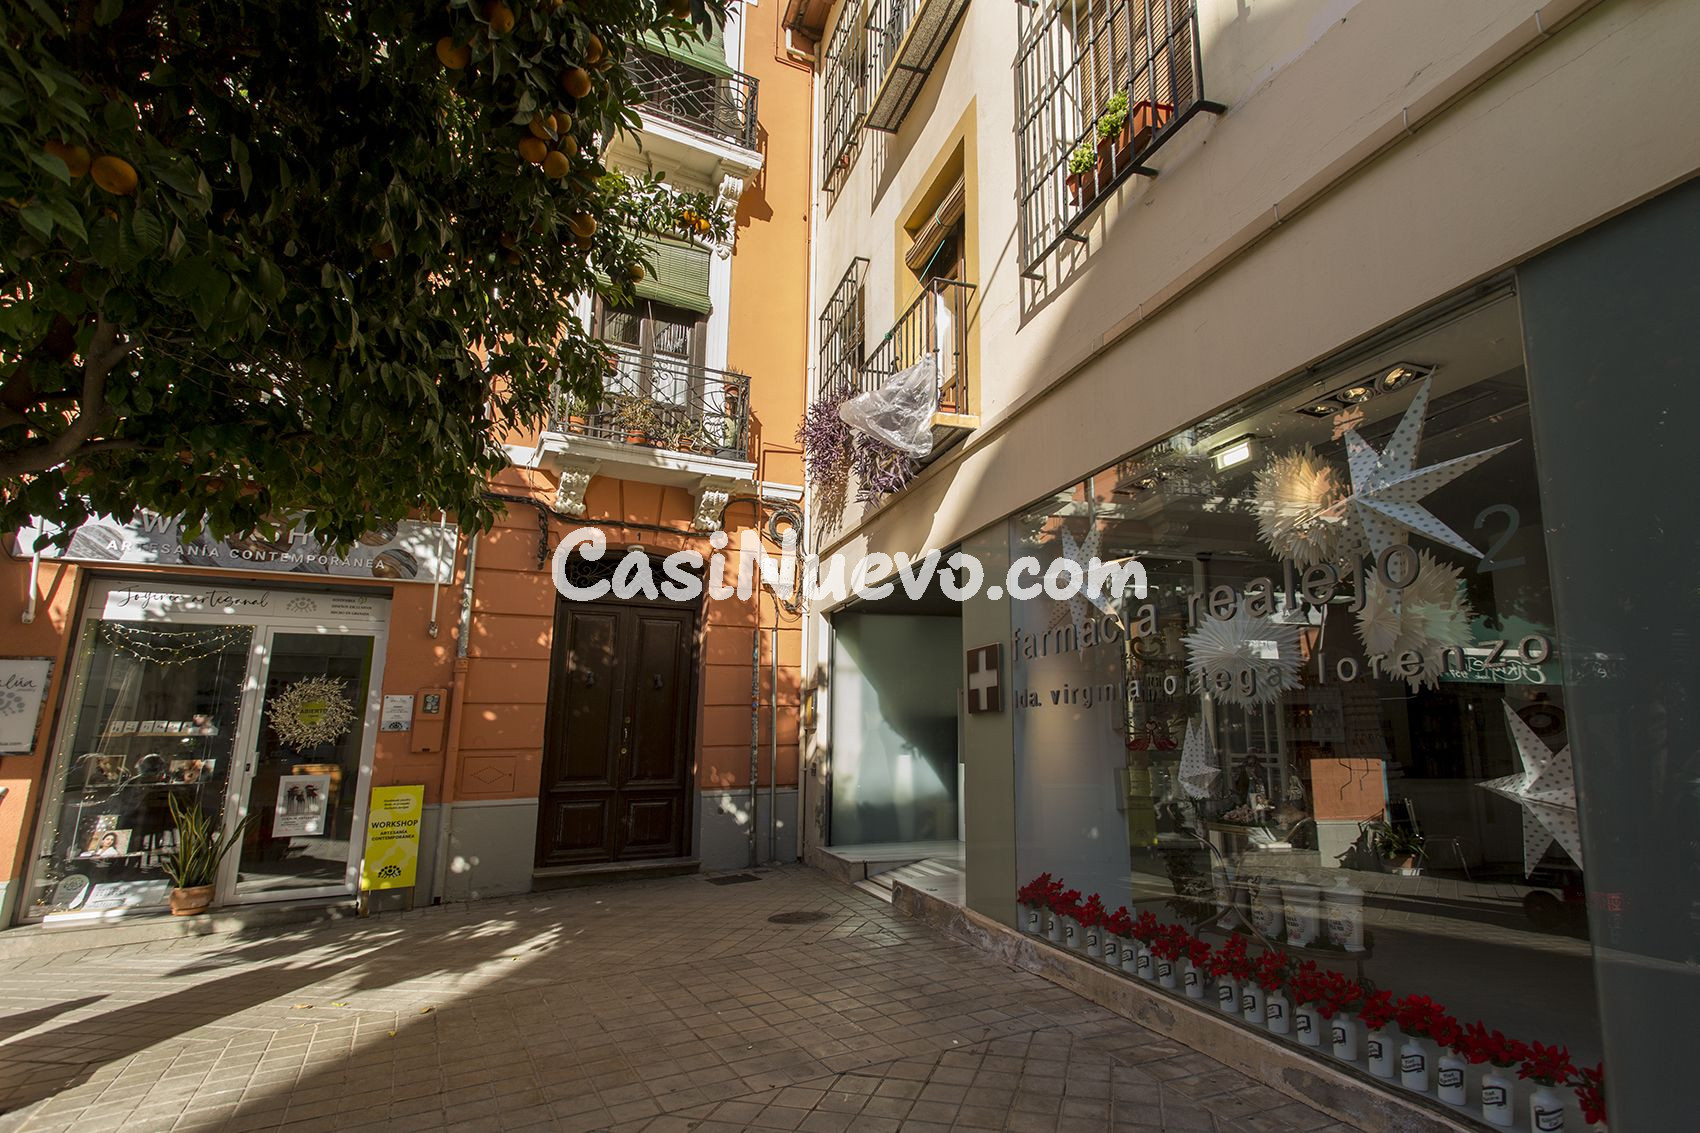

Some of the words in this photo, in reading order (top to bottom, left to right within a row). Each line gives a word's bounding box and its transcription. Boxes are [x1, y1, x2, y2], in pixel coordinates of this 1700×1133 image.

[1473, 503, 1527, 575] 2
[191, 590, 271, 608] artesanal
[1012, 602, 1160, 661] farmacia
[1187, 540, 1421, 628] realejo
[1015, 688, 1042, 708] lda.
[1050, 680, 1140, 709] virginia
[1163, 664, 1284, 698] ortega
[1317, 633, 1551, 685] lorenzo
[371, 819, 419, 829] WORKSHOP
